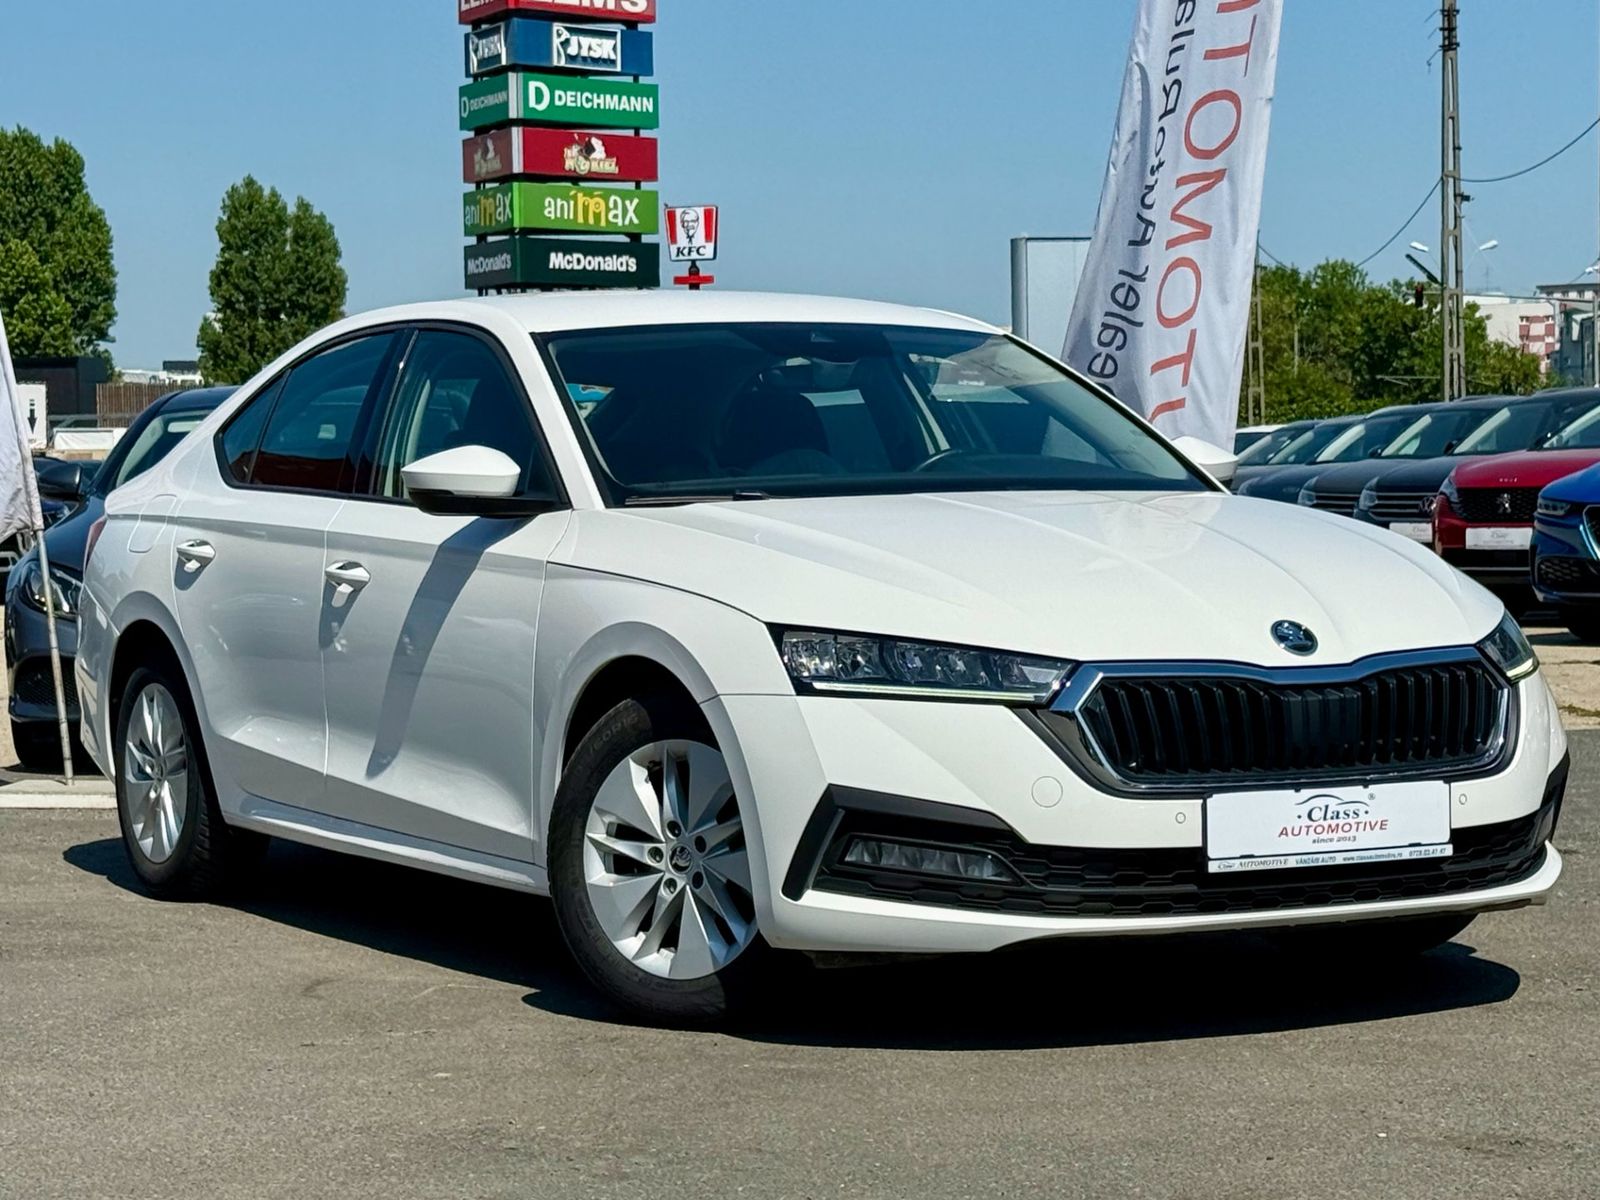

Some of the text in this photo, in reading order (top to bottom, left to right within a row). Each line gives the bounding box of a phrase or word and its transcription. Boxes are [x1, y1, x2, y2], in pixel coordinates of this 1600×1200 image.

[566, 35, 617, 60] JYSK
[470, 90, 508, 111] DEICHMANN
[554, 89, 653, 113] DEICHMANN
[465, 192, 512, 227] animax
[544, 190, 640, 227] animax
[675, 245, 706, 258] KFC
[467, 252, 511, 275] McDonald's
[549, 252, 637, 272] McDonald's
[1307, 804, 1361, 823] Class
[1278, 819, 1389, 838] AUTOMOTIVE
[1336, 835, 1357, 843] 2013
[1239, 858, 1289, 869] AUTOMOTIVE
